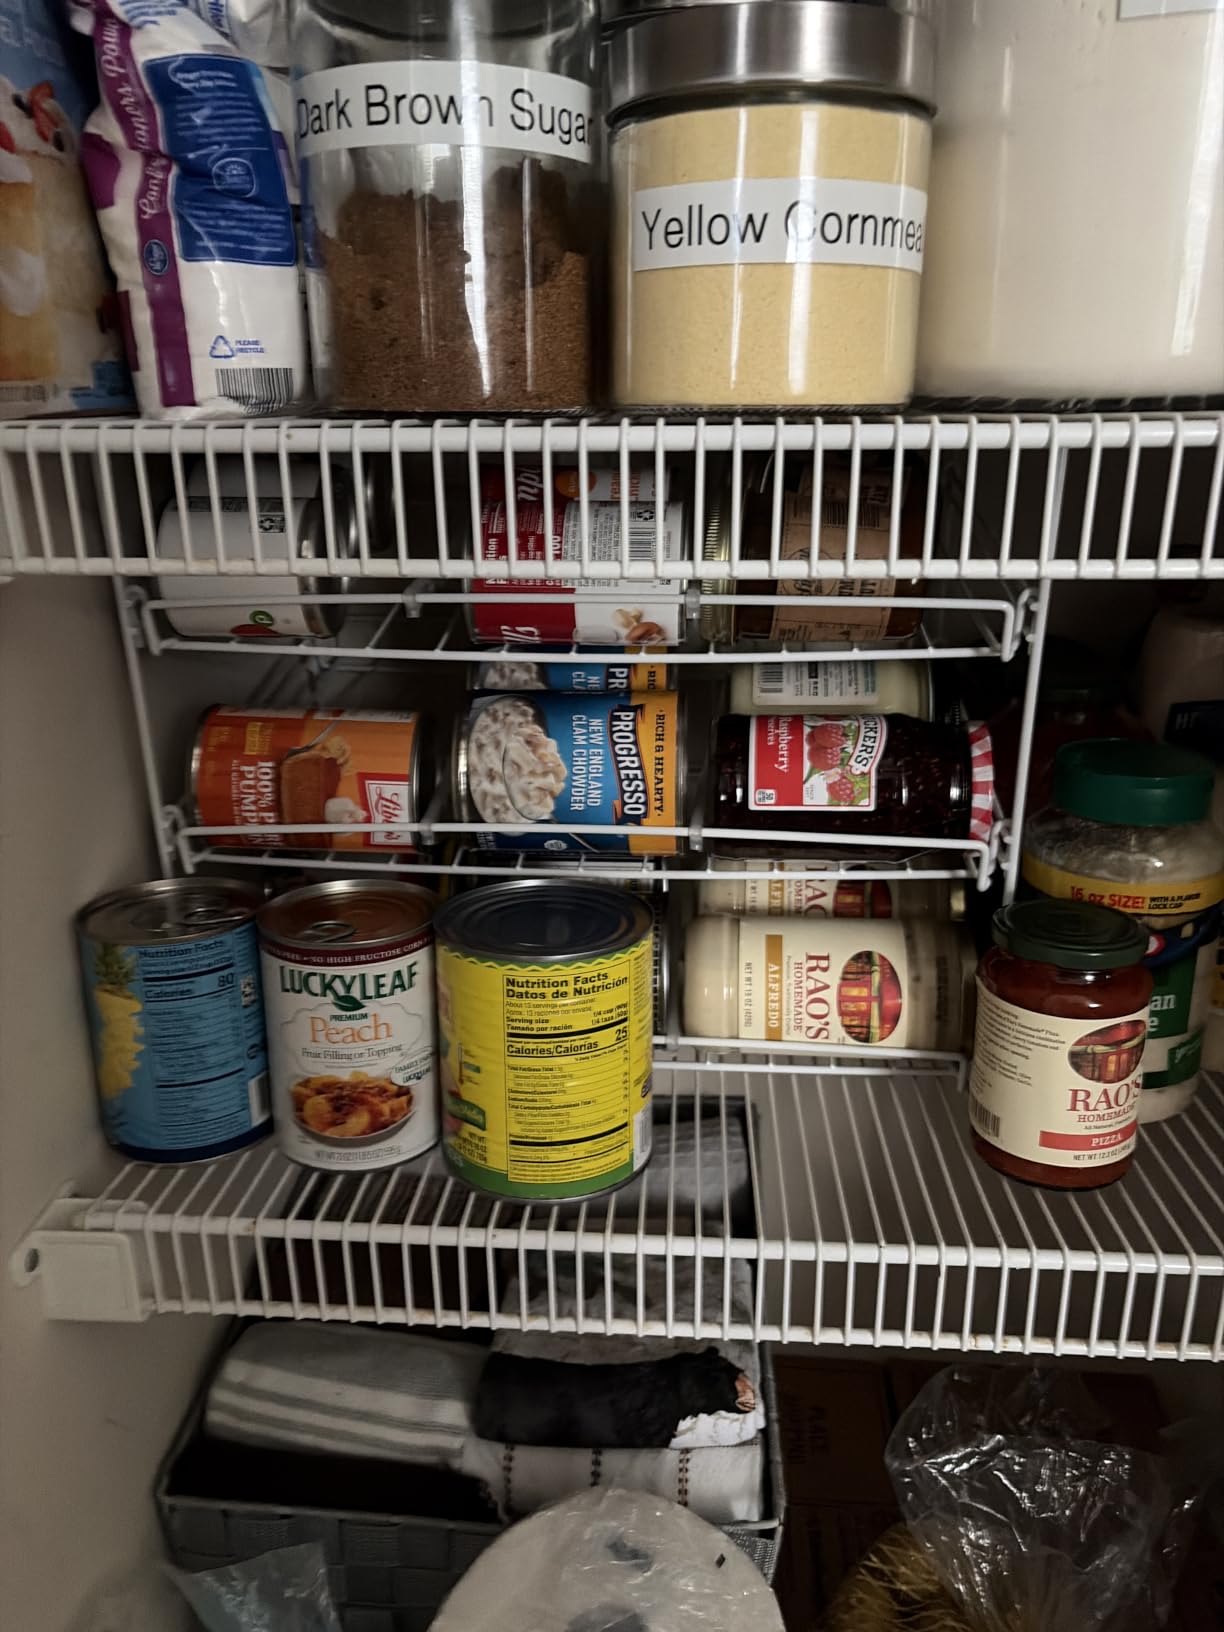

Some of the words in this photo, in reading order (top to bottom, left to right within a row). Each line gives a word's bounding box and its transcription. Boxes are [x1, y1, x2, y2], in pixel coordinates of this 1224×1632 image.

[295, 88, 352, 139] Dark
[364, 84, 494, 127] Brown
[641, 204, 769, 251] Yellow
[571, 714, 587, 746] CLAM
[588, 718, 602, 746] NEW
[654, 713, 666, 742] RICH
[612, 710, 646, 816] PROGRESSO
[256, 761, 275, 808] 100%
[570, 748, 587, 812] CHOWDER
[587, 749, 603, 807] ENGLAND
[653, 756, 665, 812] HEARTY
[1071, 885, 1084, 901] 16
[1107, 894, 1145, 909] SIZE!
[138, 946, 192, 958] Nutrition
[327, 954, 351, 963] HIGH
[354, 948, 401, 963] FRUCTOSE
[744, 962, 753, 974] NET
[217, 972, 235, 988] 80
[505, 977, 569, 989] Nutrition
[573, 972, 609, 986] Facts
[505, 988, 546, 999] Datos
[551, 989, 568, 999] de
[573, 976, 628, 997] Nutrición
[744, 976, 753, 988] WT
[144, 988, 192, 999] Calories
[767, 963, 780, 1028] ALFREDO
[793, 961, 803, 1032] HOMEMADE
[805, 952, 831, 1040] RAO'S
[308, 1013, 393, 1044] Peach
[329, 1013, 369, 1021] PREMIUM
[506, 1017, 533, 1025] Serving
[506, 1024, 534, 1032] Tamaño
[536, 1025, 547, 1033] por
[615, 1026, 628, 1041] 25
[323, 1050, 353, 1061] Filling
[506, 1040, 599, 1056] Calories/Calorías
[1087, 1152, 1097, 1160] WT
